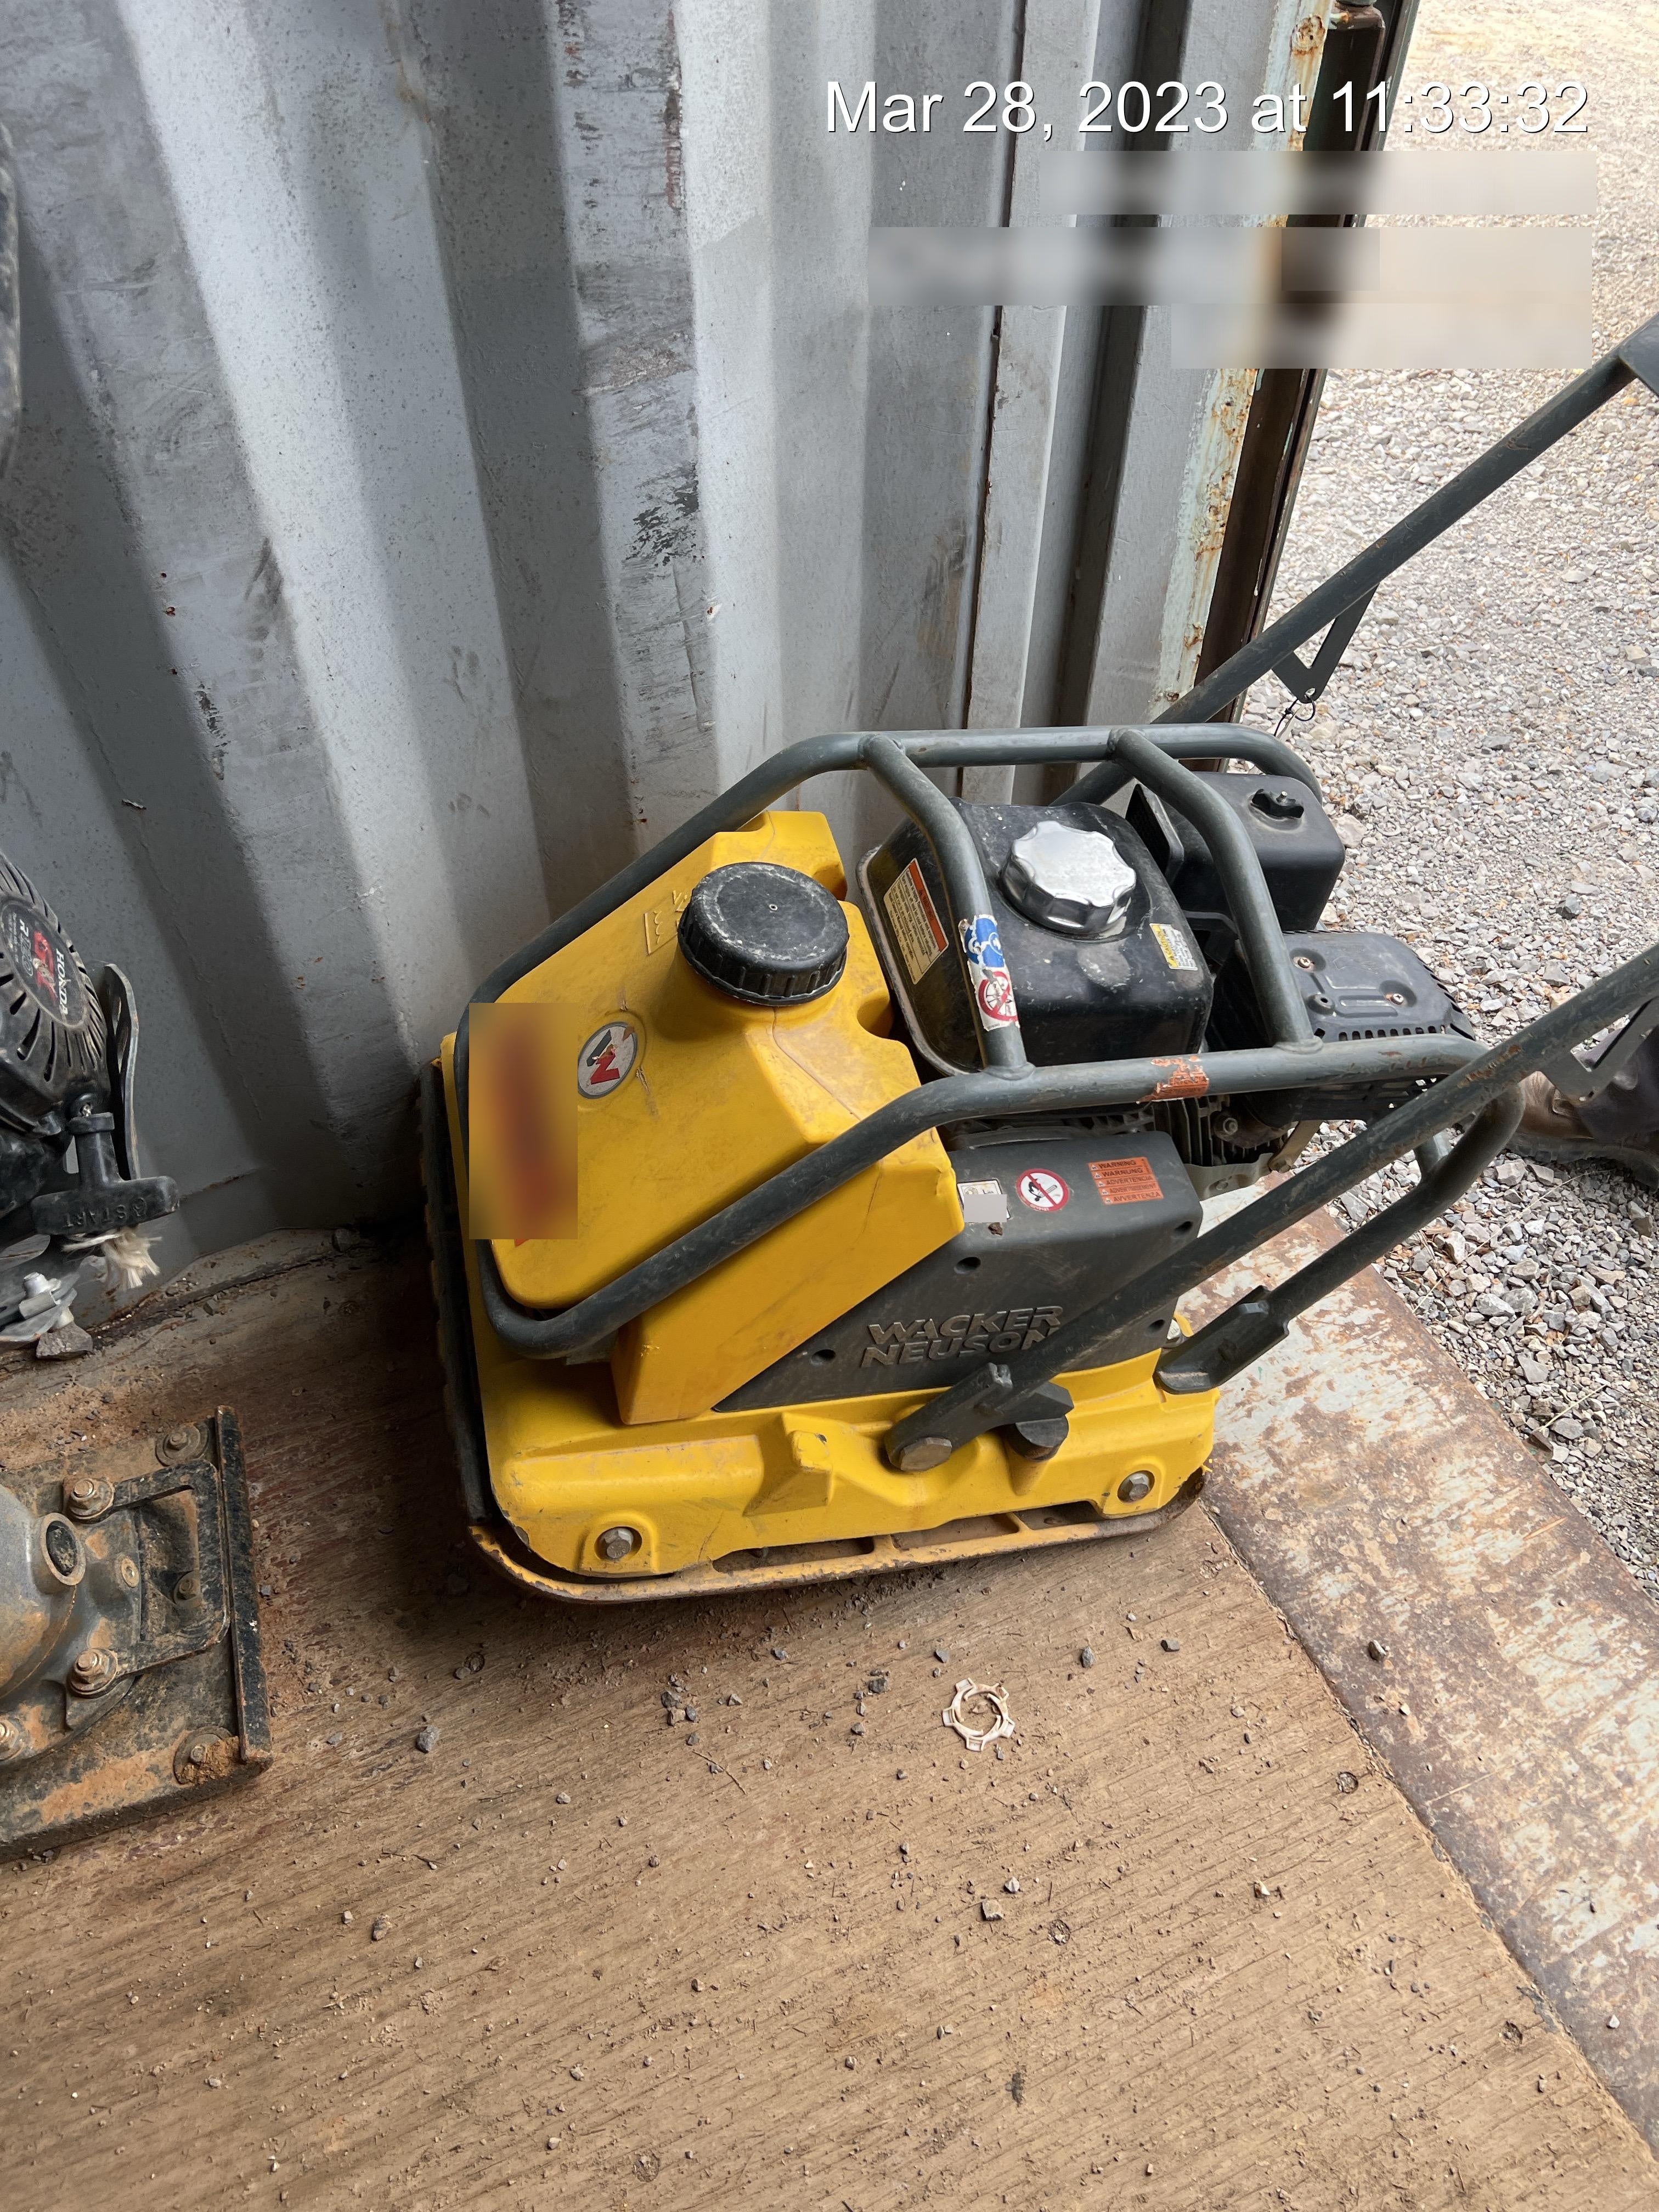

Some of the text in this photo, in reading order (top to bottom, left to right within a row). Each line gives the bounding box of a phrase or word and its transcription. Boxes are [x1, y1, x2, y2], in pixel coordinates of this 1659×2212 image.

[1157, 931, 1171, 955] CAUTION
[56, 949, 69, 1014] HONDA
[1098, 1160, 1136, 1169] WARNING
[1102, 1167, 1143, 1177] WARNUNG
[867, 1306, 1063, 1345] WACKER
